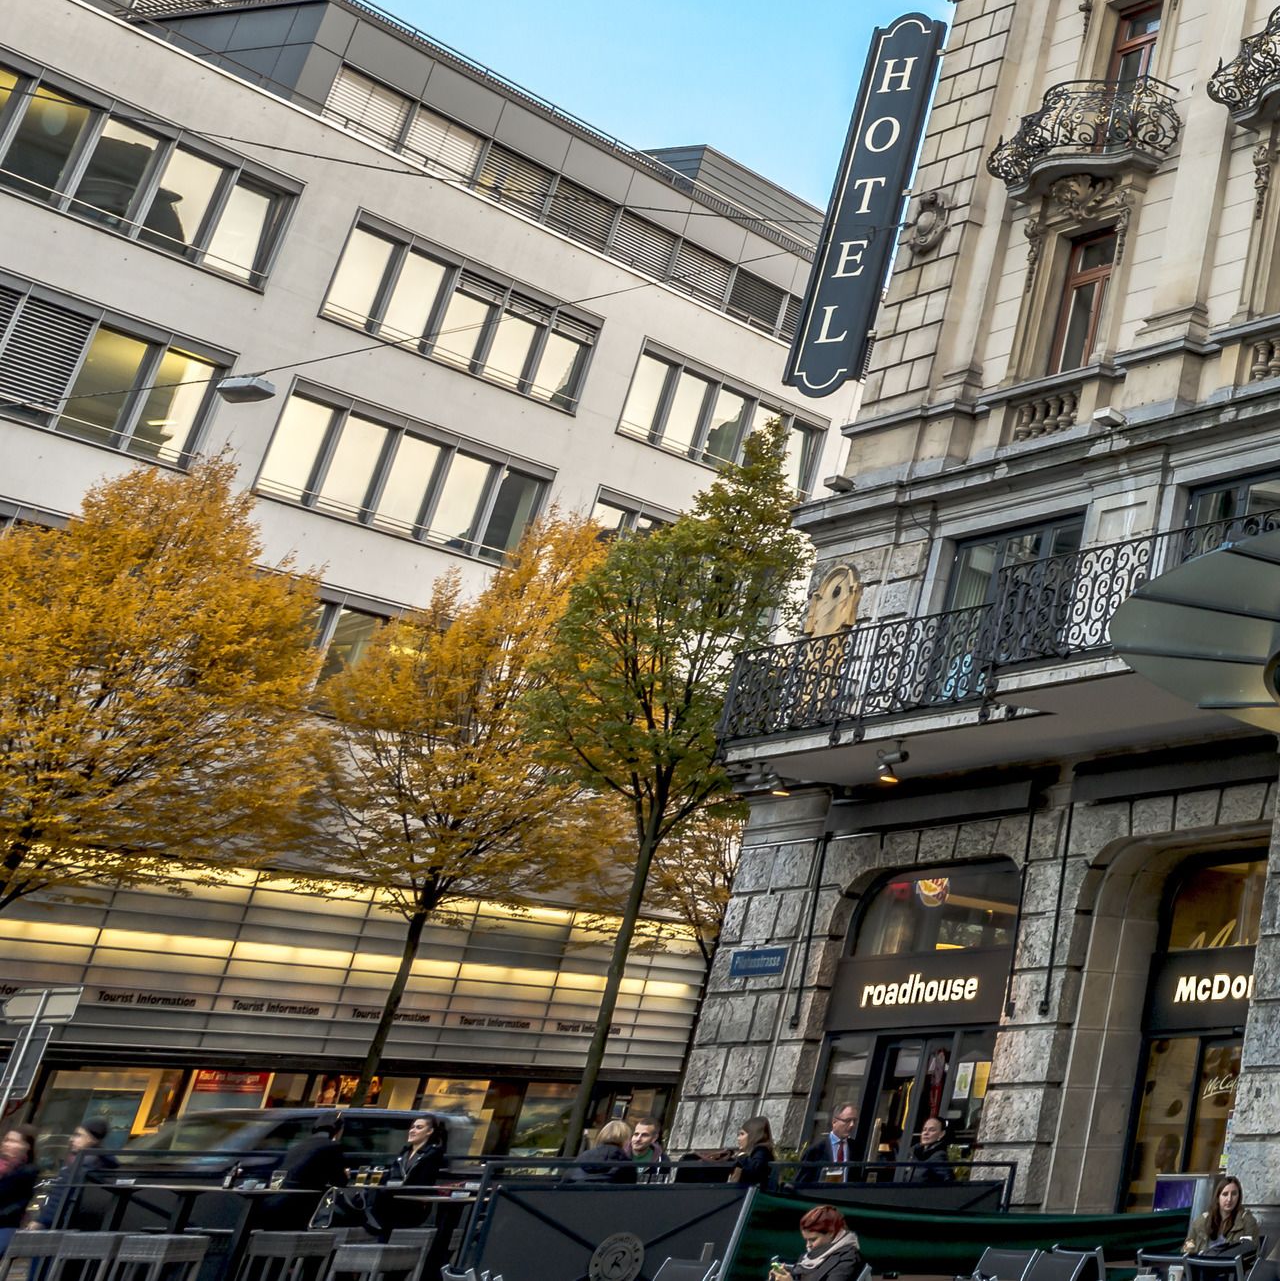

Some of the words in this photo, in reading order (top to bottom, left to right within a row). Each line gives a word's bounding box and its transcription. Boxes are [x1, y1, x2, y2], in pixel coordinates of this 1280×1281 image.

[814, 56, 918, 344] HOTEL
[98, 991, 133, 1003] Tourist
[137, 994, 196, 1007] Information
[860, 973, 979, 1008] roadhouse
[232, 1000, 264, 1012] Tourist
